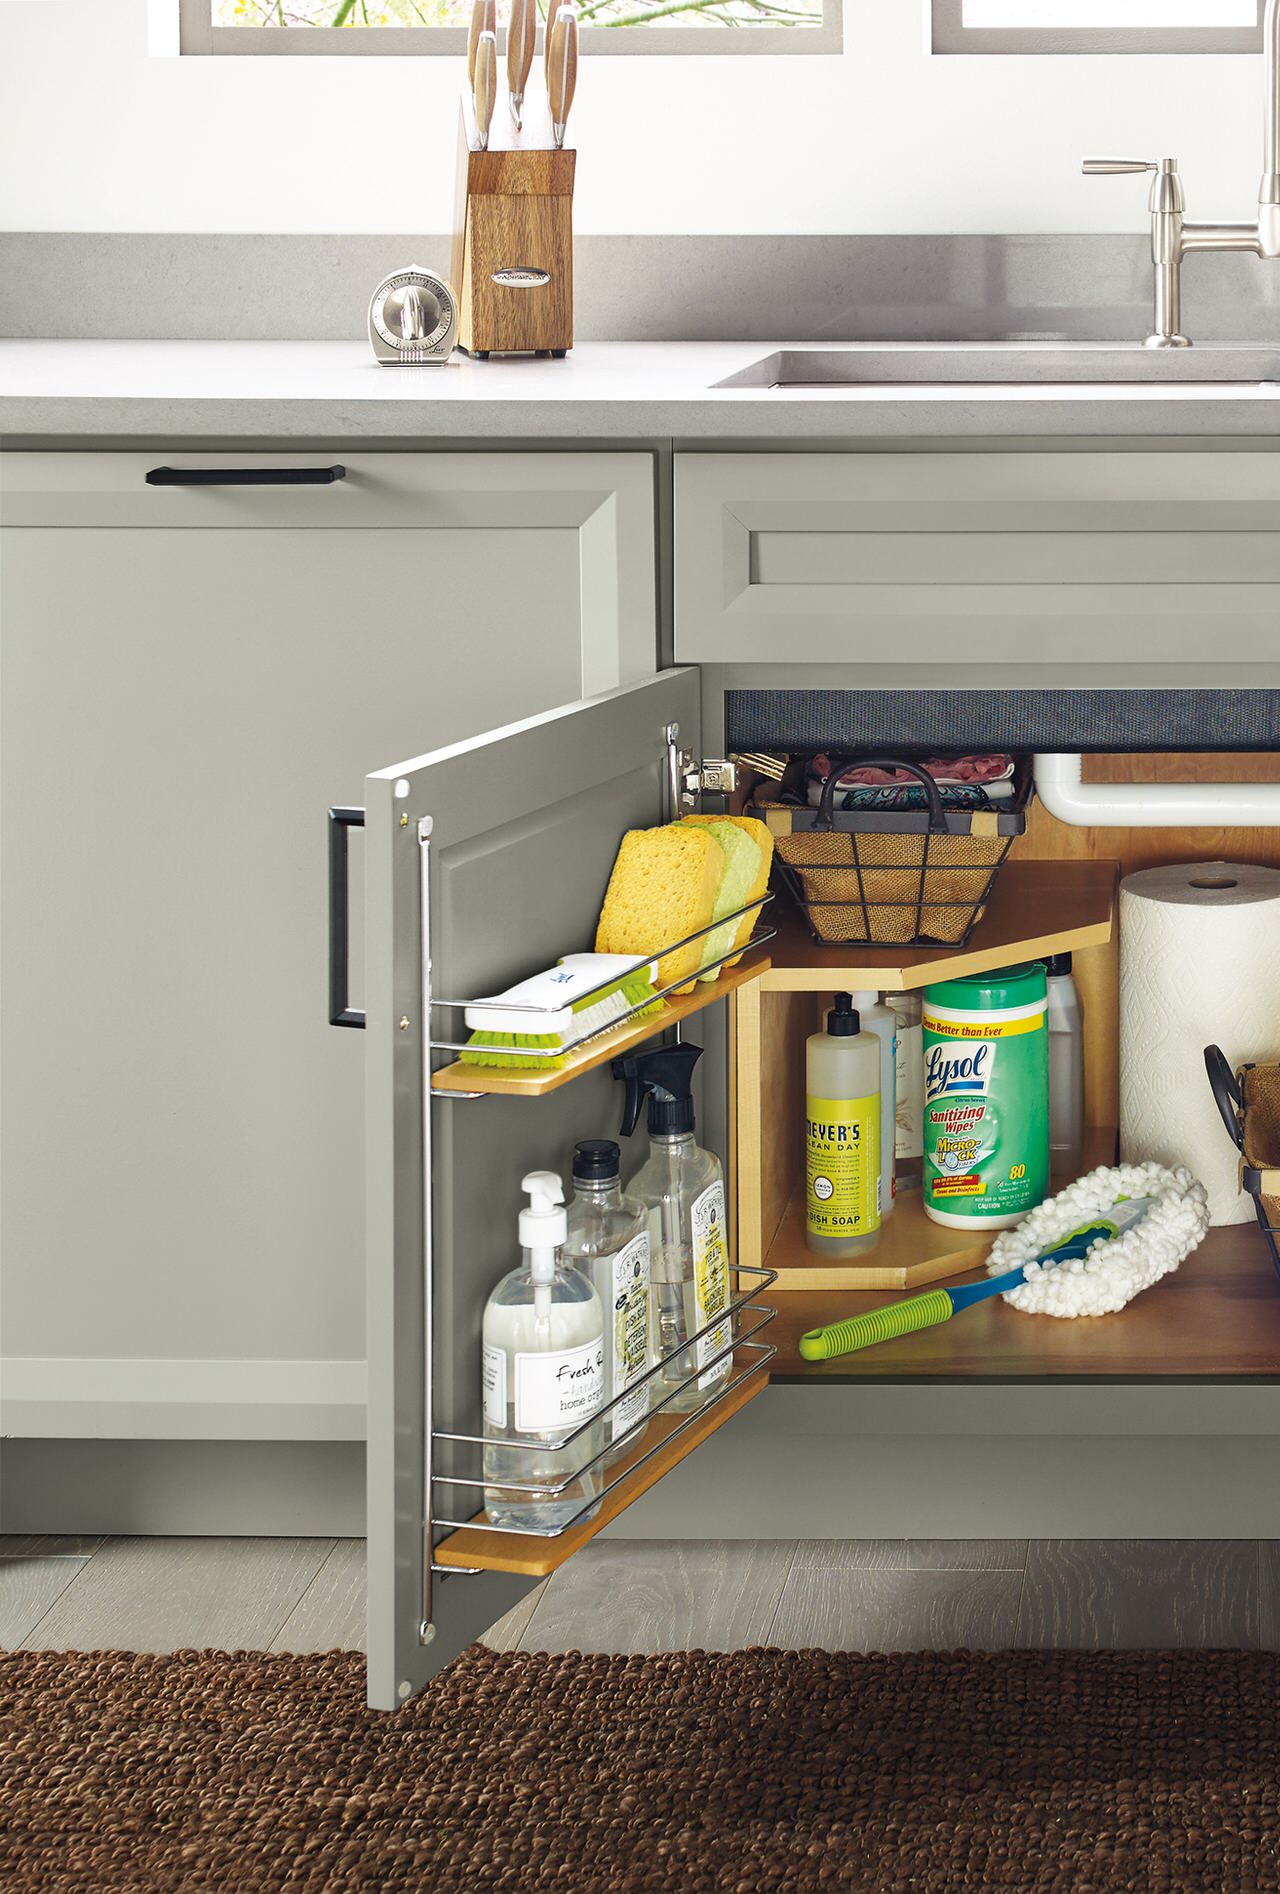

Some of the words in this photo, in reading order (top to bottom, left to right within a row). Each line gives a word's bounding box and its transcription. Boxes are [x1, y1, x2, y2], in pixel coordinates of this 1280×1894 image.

[936, 1022, 960, 1035] Better
[961, 1027, 982, 1036] than
[983, 1027, 1003, 1036] Ever
[926, 1044, 988, 1094] Lysol
[929, 1106, 986, 1122] Sanitizing
[945, 1121, 974, 1135] Wipes
[808, 1140, 831, 1151] LEAN
[837, 1142, 861, 1151] DAY
[1009, 1164, 1025, 1180] 80
[810, 1212, 828, 1224] DISH
[832, 1216, 860, 1225] SOAP
[555, 1358, 595, 1381] Fresh
[560, 1396, 586, 1411] home
